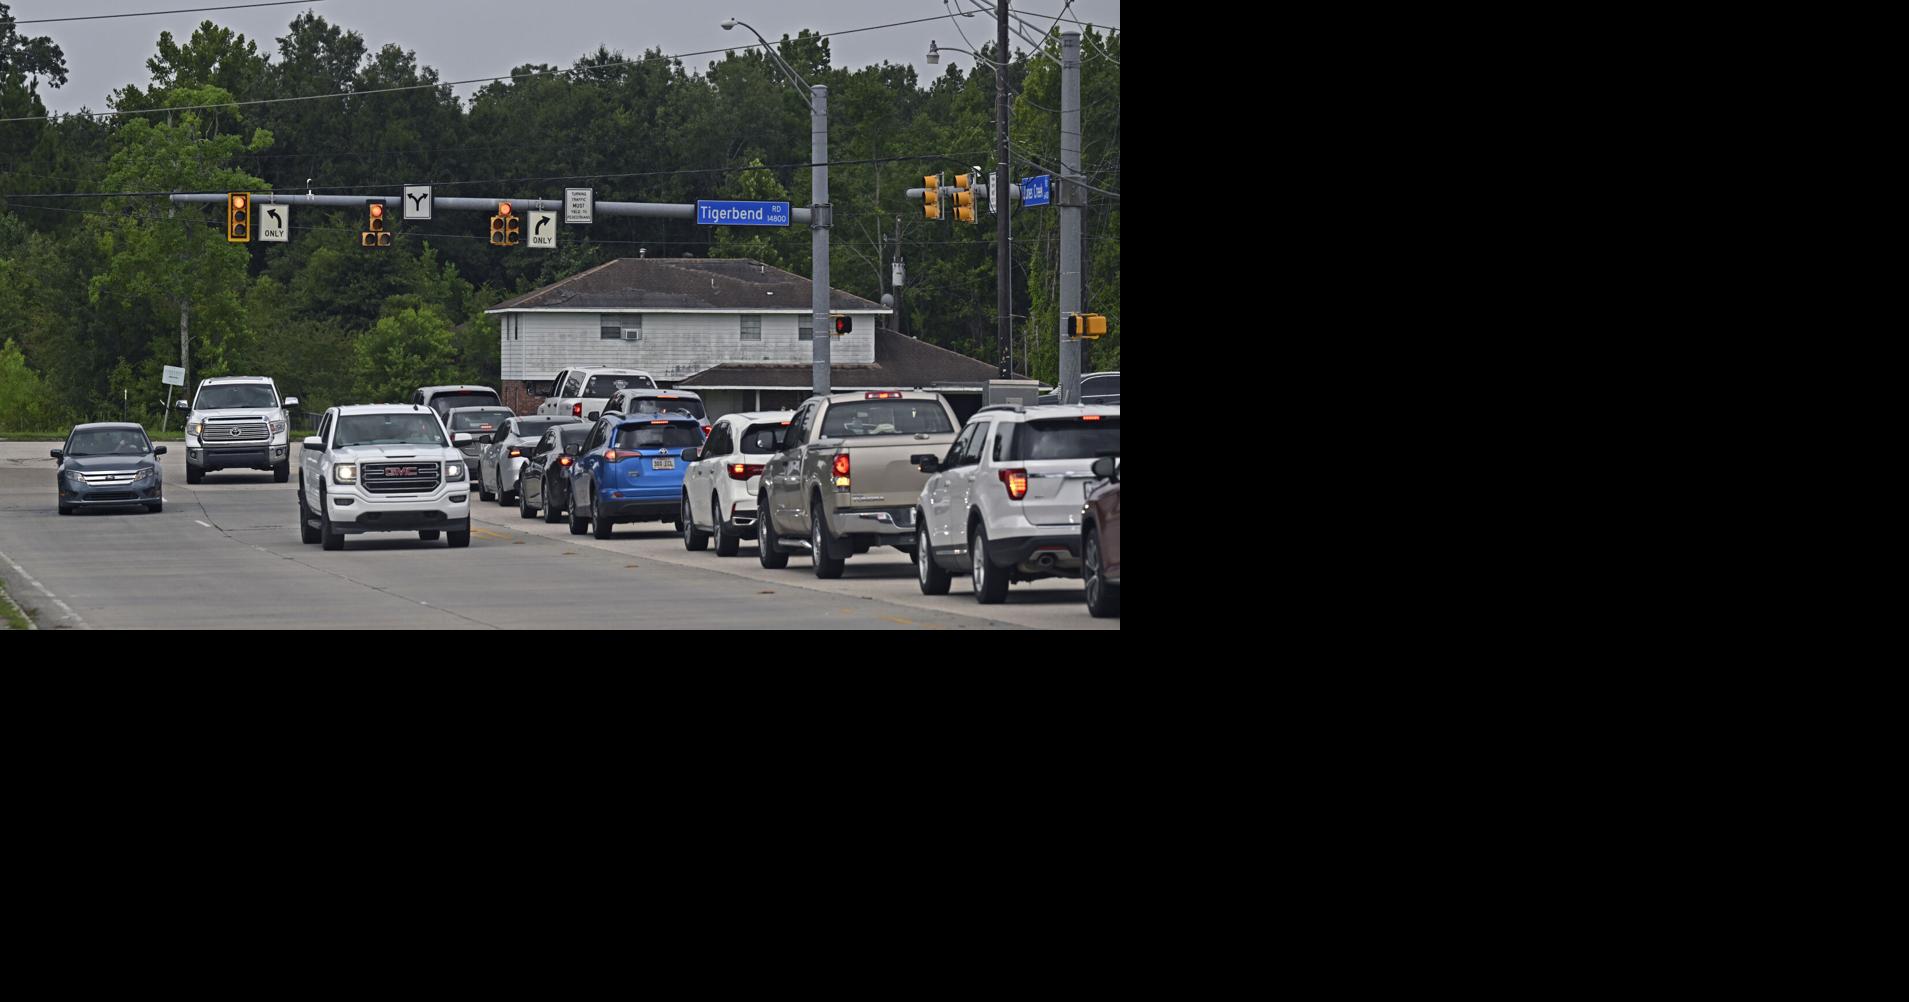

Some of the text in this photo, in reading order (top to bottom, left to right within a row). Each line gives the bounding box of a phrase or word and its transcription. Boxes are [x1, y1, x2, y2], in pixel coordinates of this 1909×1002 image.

[771, 205, 782, 213] RD
[700, 206, 763, 223] Tigerbend
[264, 230, 284, 238] ONLY
[533, 236, 552, 245] ONLY
[384, 466, 418, 476] GMC
